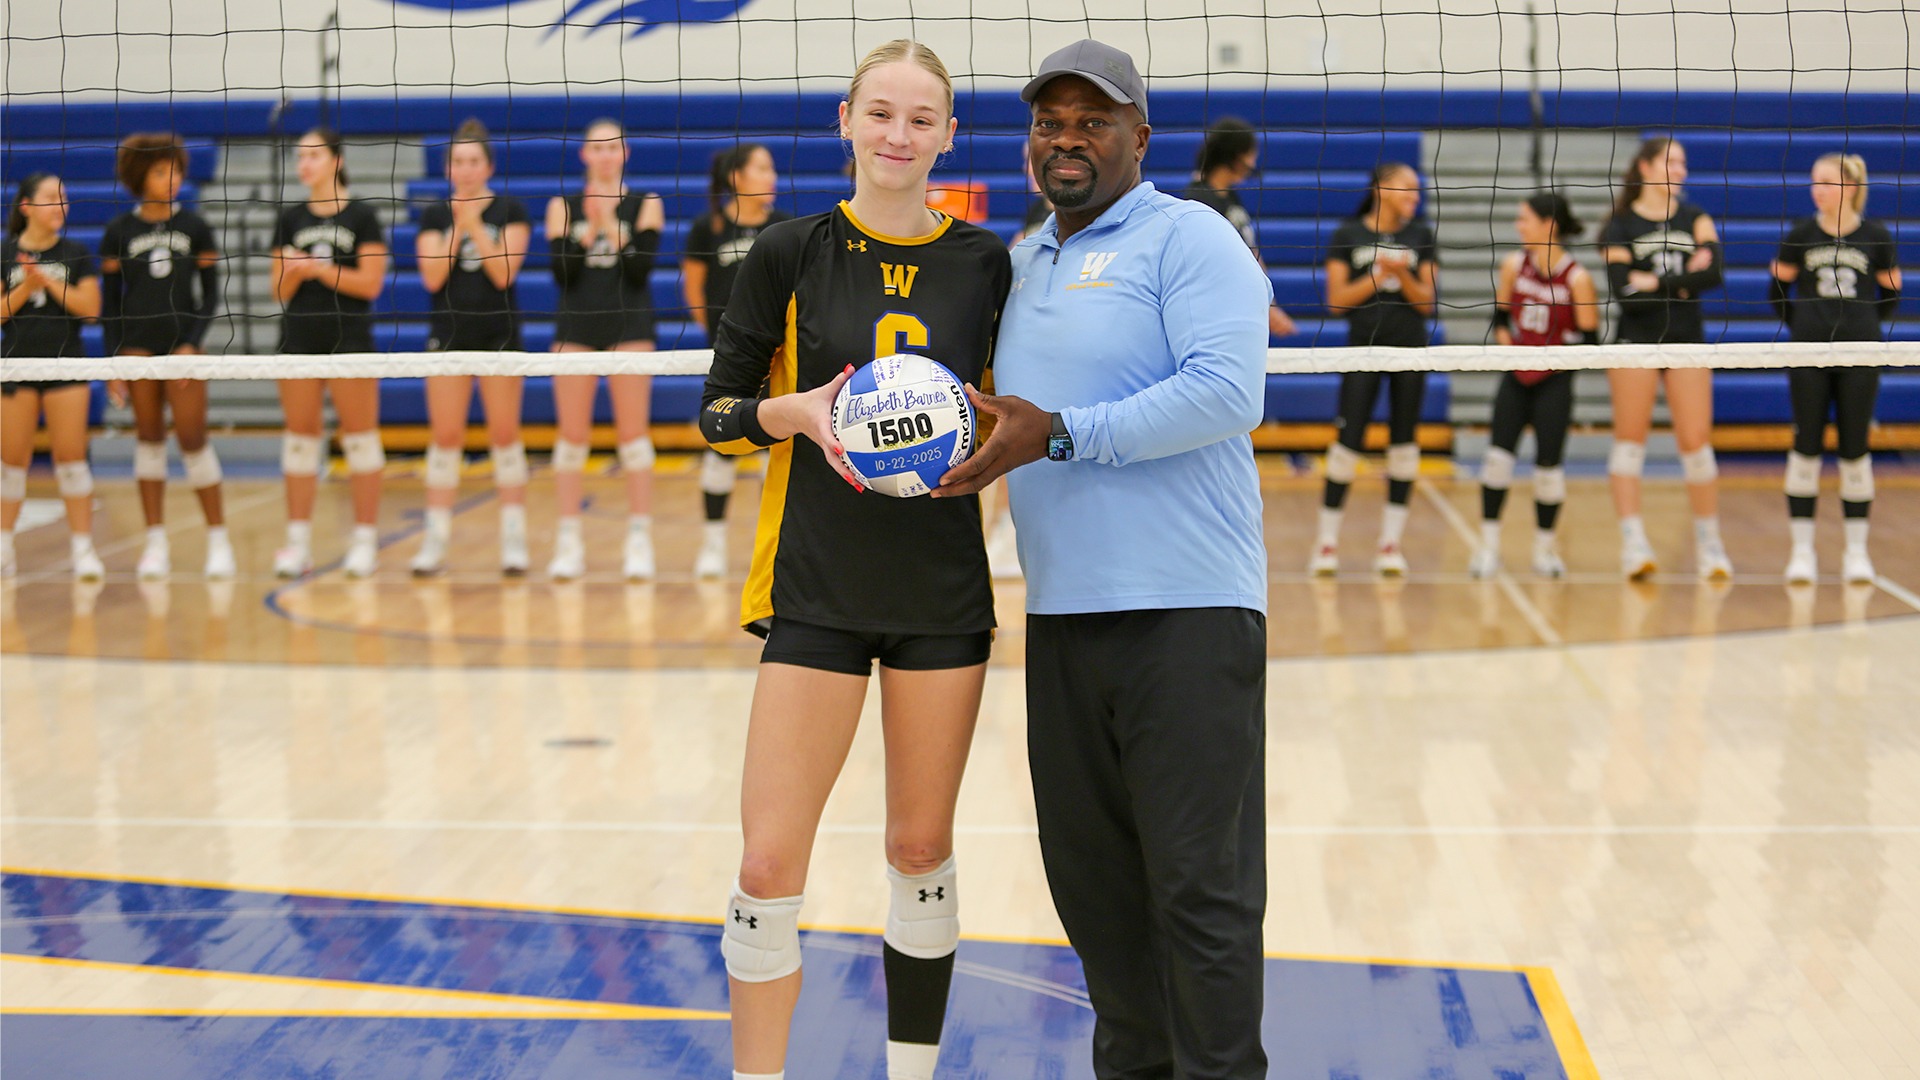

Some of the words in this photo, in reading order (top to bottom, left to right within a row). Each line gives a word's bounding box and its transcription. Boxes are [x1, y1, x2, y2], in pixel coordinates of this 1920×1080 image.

[880, 262, 919, 298] W
[1079, 252, 1119, 281] W
[846, 391, 904, 424] Elizabeth
[904, 389, 947, 410] Barnes
[867, 412, 933, 448] 1500
[874, 446, 942, 472] 10-22-2025
